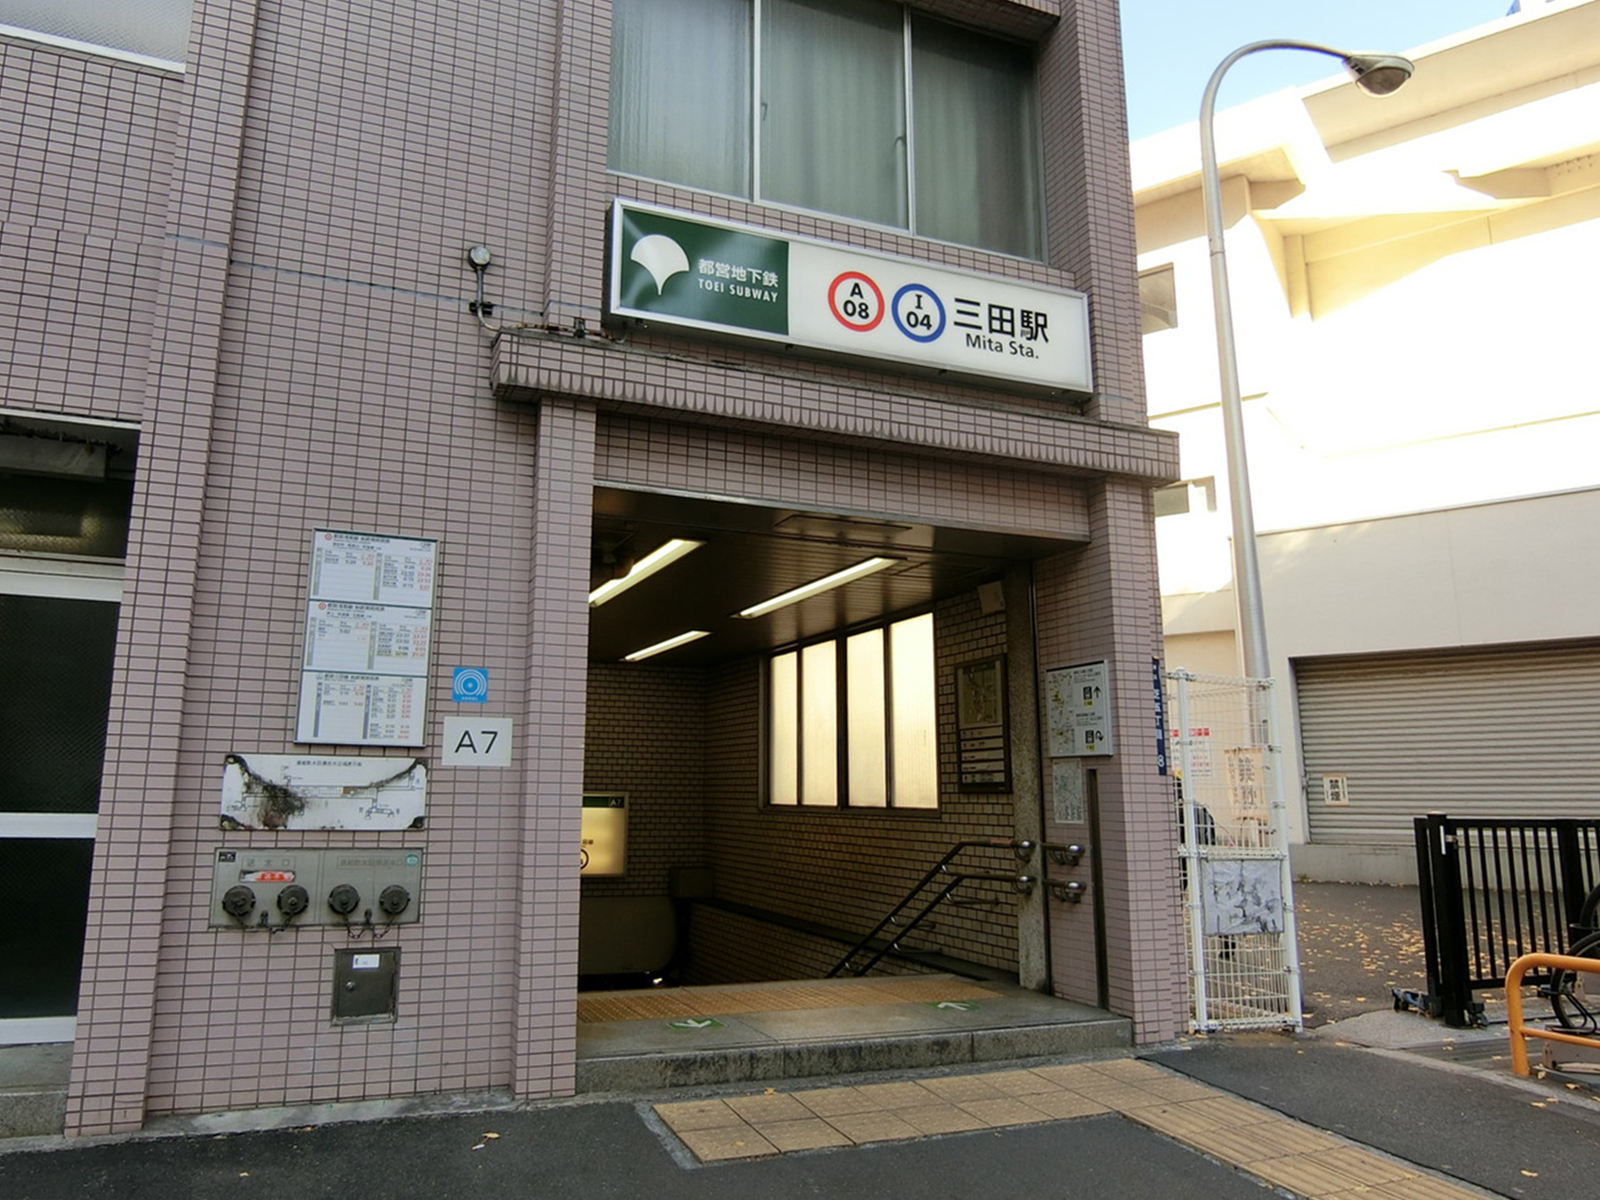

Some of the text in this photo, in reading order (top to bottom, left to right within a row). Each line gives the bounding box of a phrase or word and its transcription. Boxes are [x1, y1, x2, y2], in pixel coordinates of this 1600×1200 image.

[698, 259, 779, 288] 都営地下鉄
[698, 278, 778, 302] TOEI SUBWAY
[850, 282, 864, 299] A
[914, 293, 923, 310] I
[843, 299, 870, 320] 08
[906, 311, 932, 330] 04
[953, 297, 1050, 343] 三田駅
[966, 333, 1039, 359] Mita Sta.
[454, 730, 498, 754] A7
